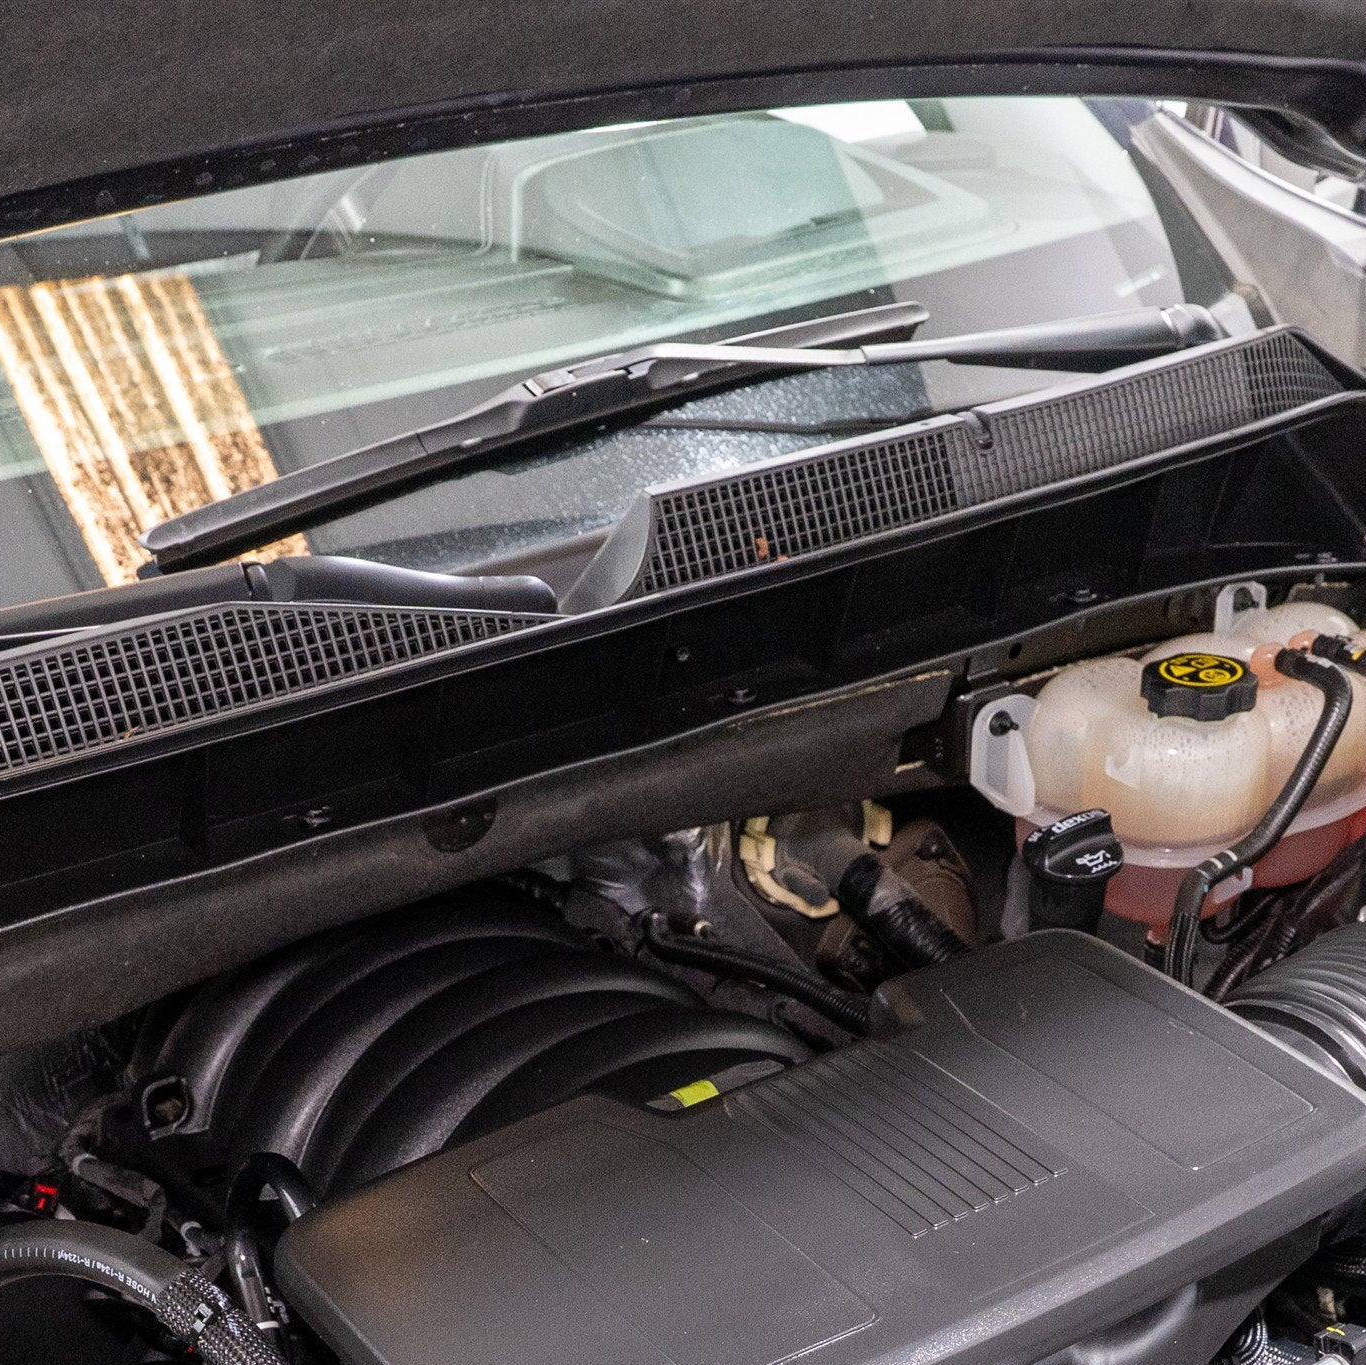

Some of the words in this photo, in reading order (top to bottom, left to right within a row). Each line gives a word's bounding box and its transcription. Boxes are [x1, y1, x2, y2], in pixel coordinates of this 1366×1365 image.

[57, 1249, 91, 1268] R-1234yf
[96, 1261, 125, 1283] R-134a
[125, 1276, 150, 1298] HOSE
